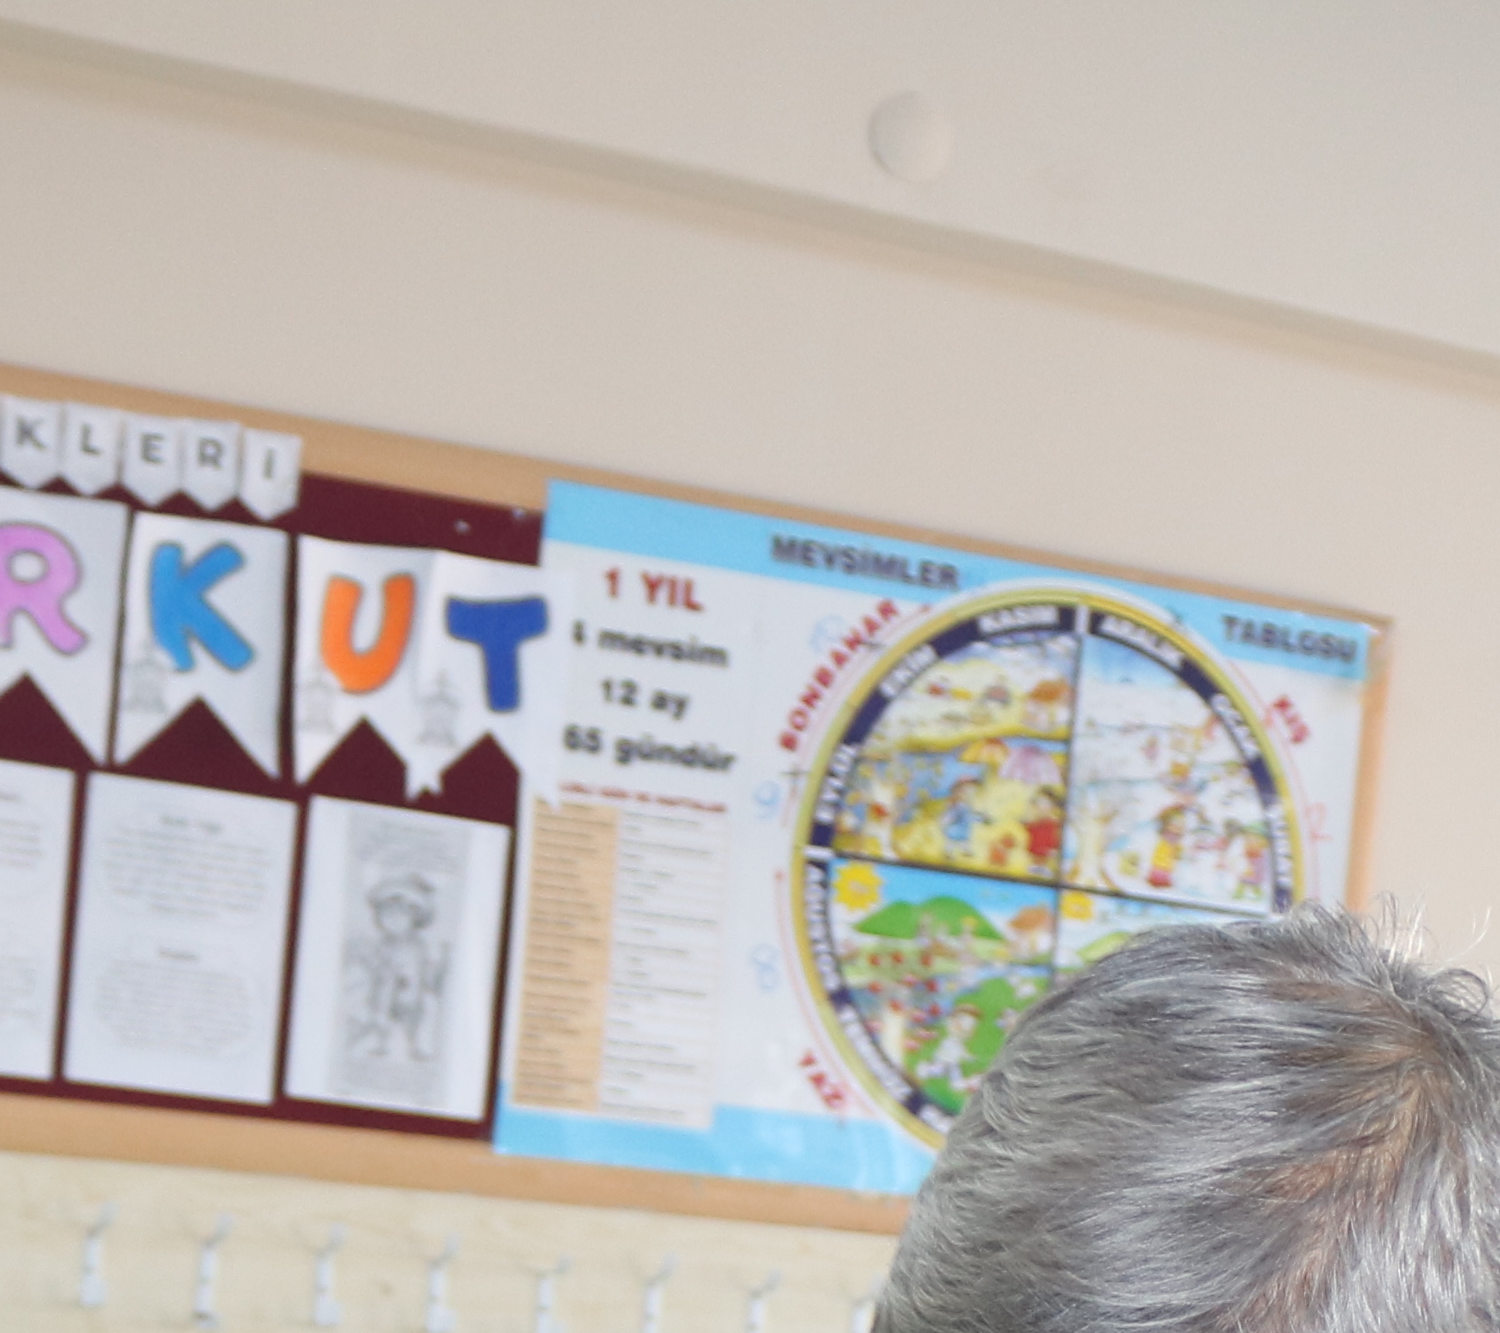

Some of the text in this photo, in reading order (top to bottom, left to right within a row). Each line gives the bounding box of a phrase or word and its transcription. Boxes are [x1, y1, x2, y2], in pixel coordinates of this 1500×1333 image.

[606, 566, 705, 612] 1 YIL
[598, 628, 729, 667] mevsim
[1221, 615, 1359, 663] TABLOSU
[602, 678, 691, 720] 12 ay
[563, 723, 736, 773] 65 gündür
